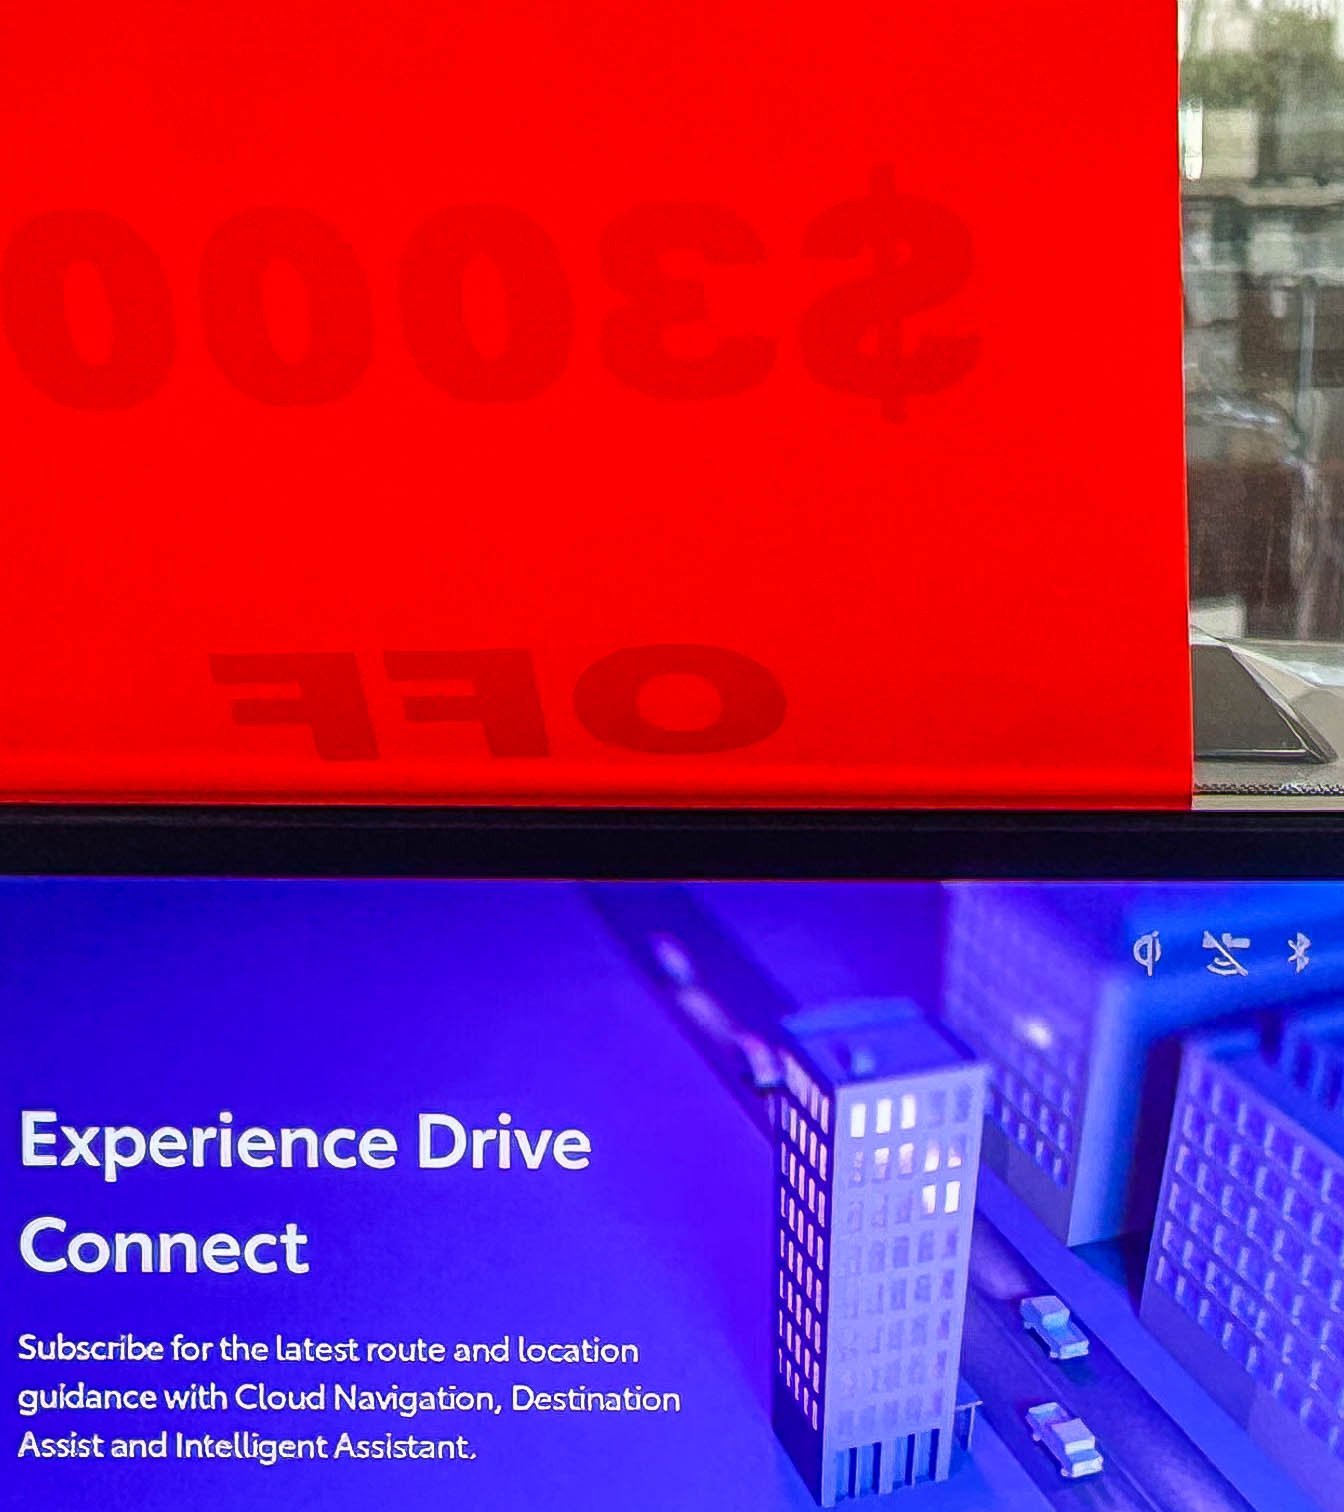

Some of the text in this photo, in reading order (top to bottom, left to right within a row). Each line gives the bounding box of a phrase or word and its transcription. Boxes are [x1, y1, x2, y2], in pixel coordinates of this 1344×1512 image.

[21, 1110, 591, 1183] Experience Drive
[20, 1216, 309, 1274] Connect
[17, 1332, 639, 1363] Subscribe for the latest route and location
[17, 1382, 681, 1418] guidance with Cloud Navigation, Destination
[17, 1430, 476, 1466] Assist and Intelligent Assistant.
